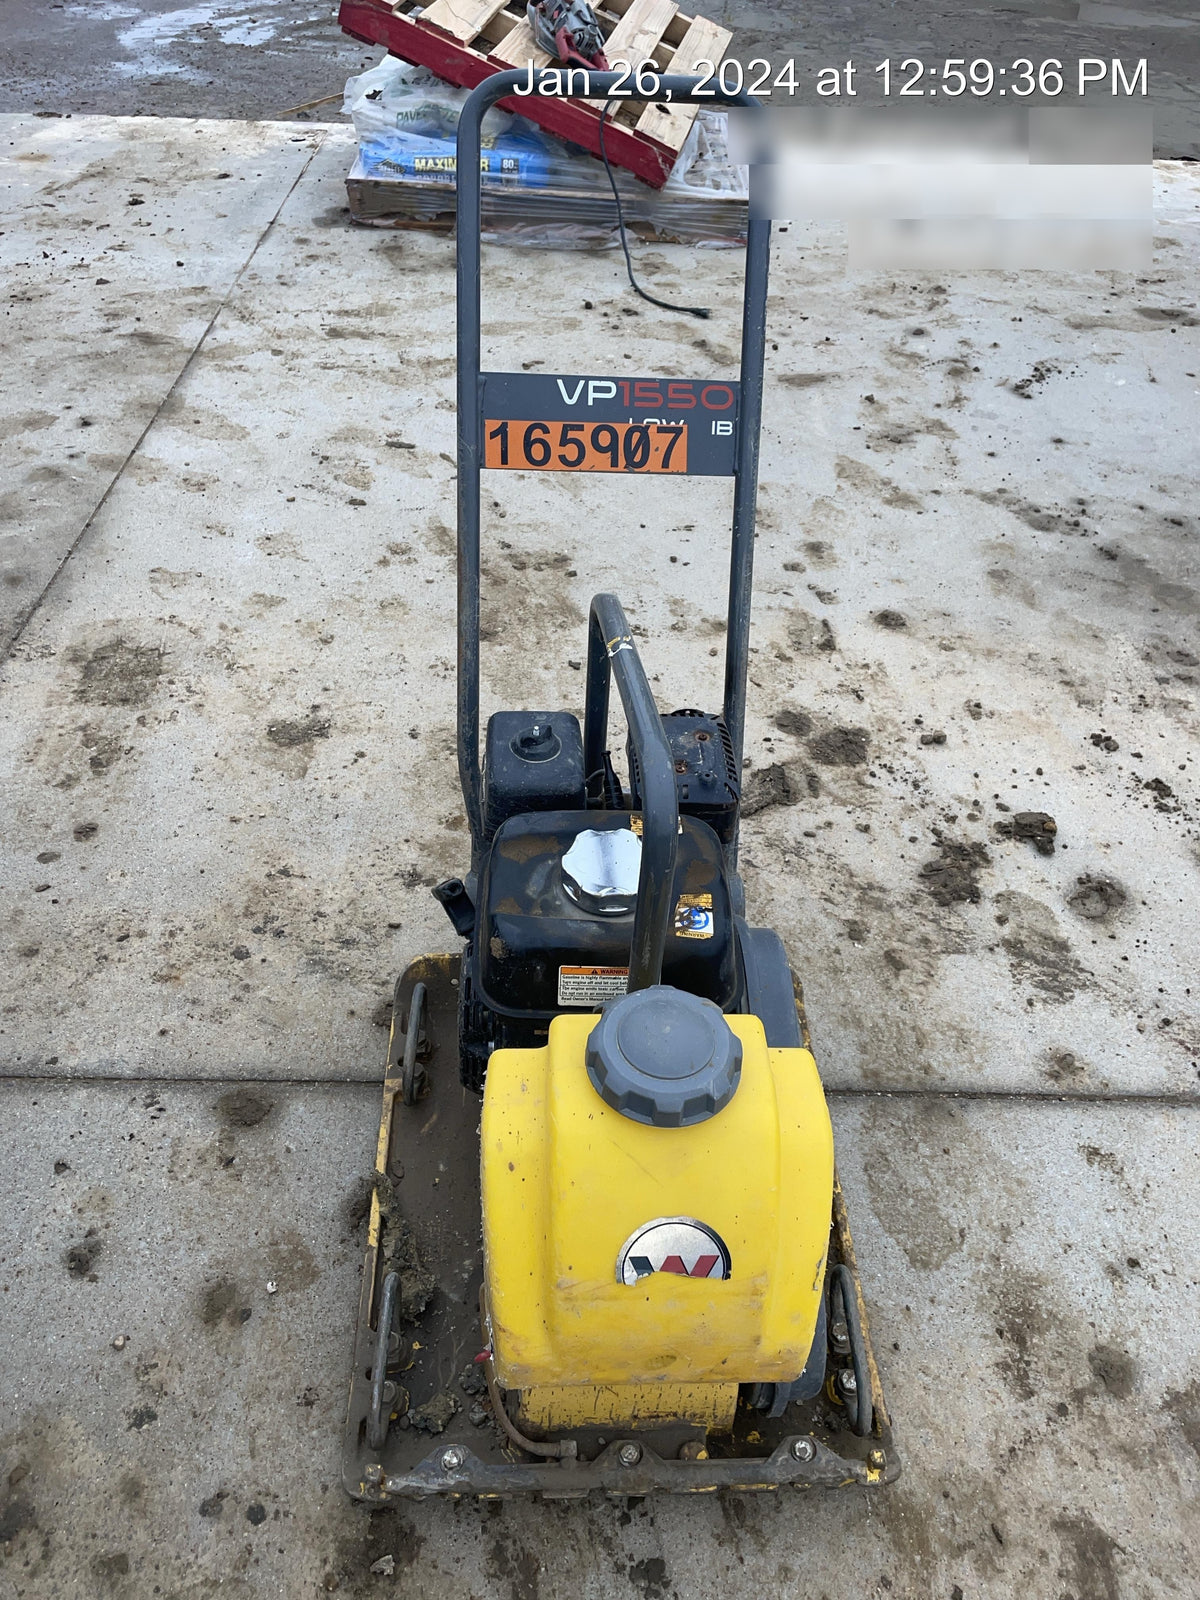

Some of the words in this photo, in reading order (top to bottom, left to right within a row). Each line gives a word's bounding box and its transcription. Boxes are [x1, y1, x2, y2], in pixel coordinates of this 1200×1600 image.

[502, 159, 514, 169] 80
[556, 378, 734, 410] VP1550
[488, 421, 685, 470] 165907
